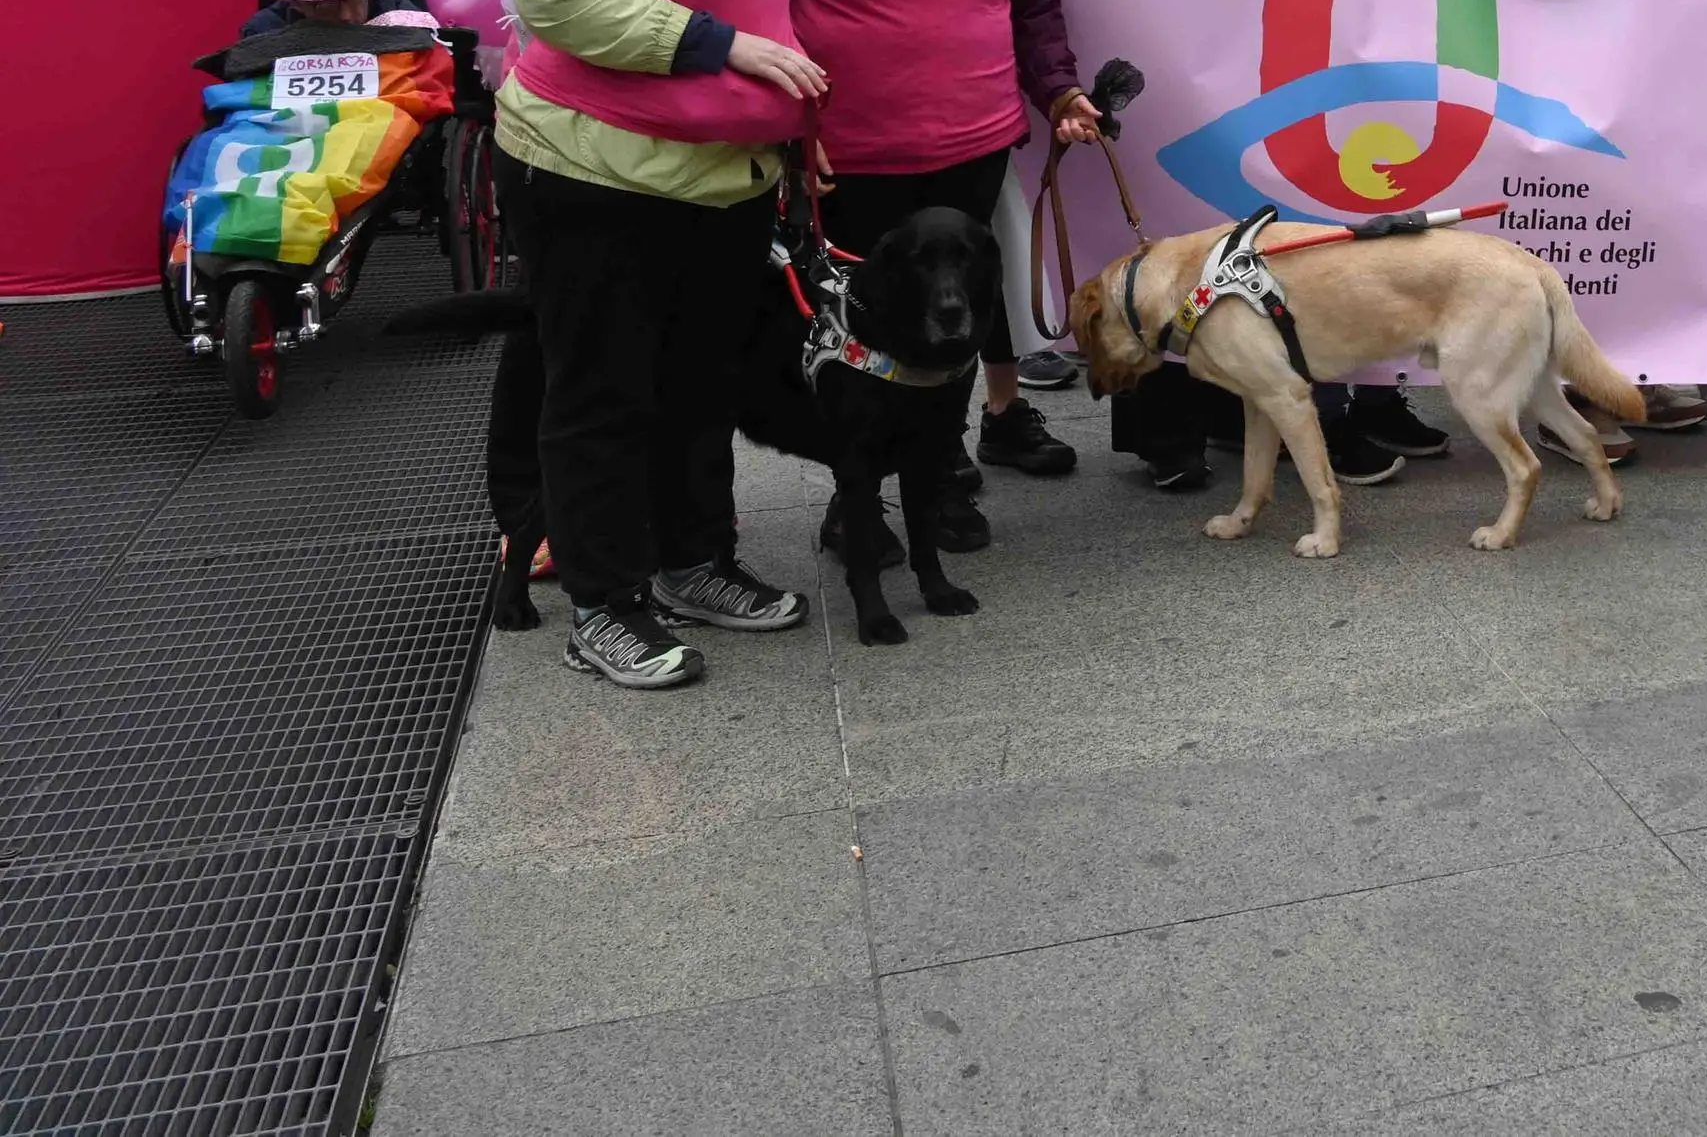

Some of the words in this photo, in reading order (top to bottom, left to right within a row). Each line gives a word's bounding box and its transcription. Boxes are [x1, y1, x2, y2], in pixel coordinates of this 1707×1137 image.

[288, 57, 334, 71] CORSA
[287, 73, 366, 97] 5254
[1502, 176, 1590, 198] Unione
[1499, 208, 1587, 231] Italiana
[1596, 209, 1631, 231] dei
[1579, 247, 1592, 263] e
[1600, 241, 1656, 270] degli
